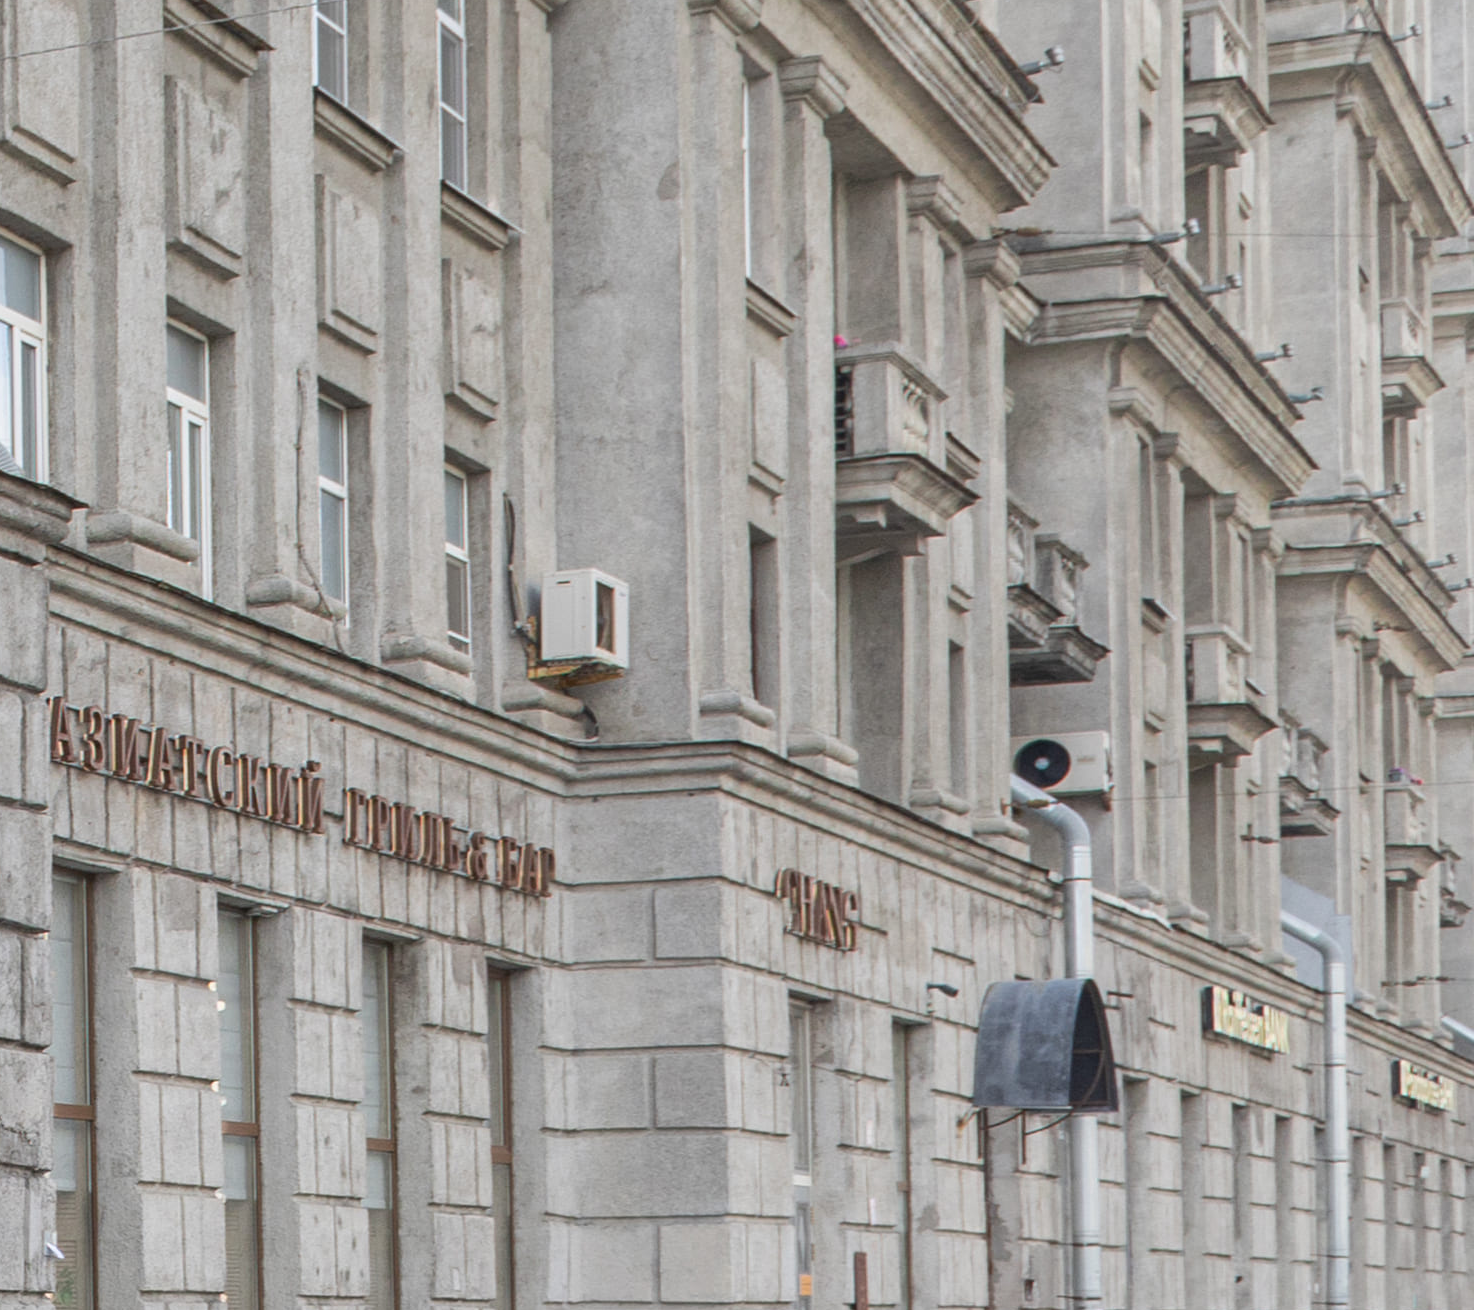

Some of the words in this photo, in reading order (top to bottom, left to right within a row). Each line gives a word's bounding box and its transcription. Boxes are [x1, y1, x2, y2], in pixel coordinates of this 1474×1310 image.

[48, 696, 325, 835] АЗИАТСКИЙ
[344, 788, 460, 872] ГРИЛЬ
[496, 836, 555, 897] БАР
